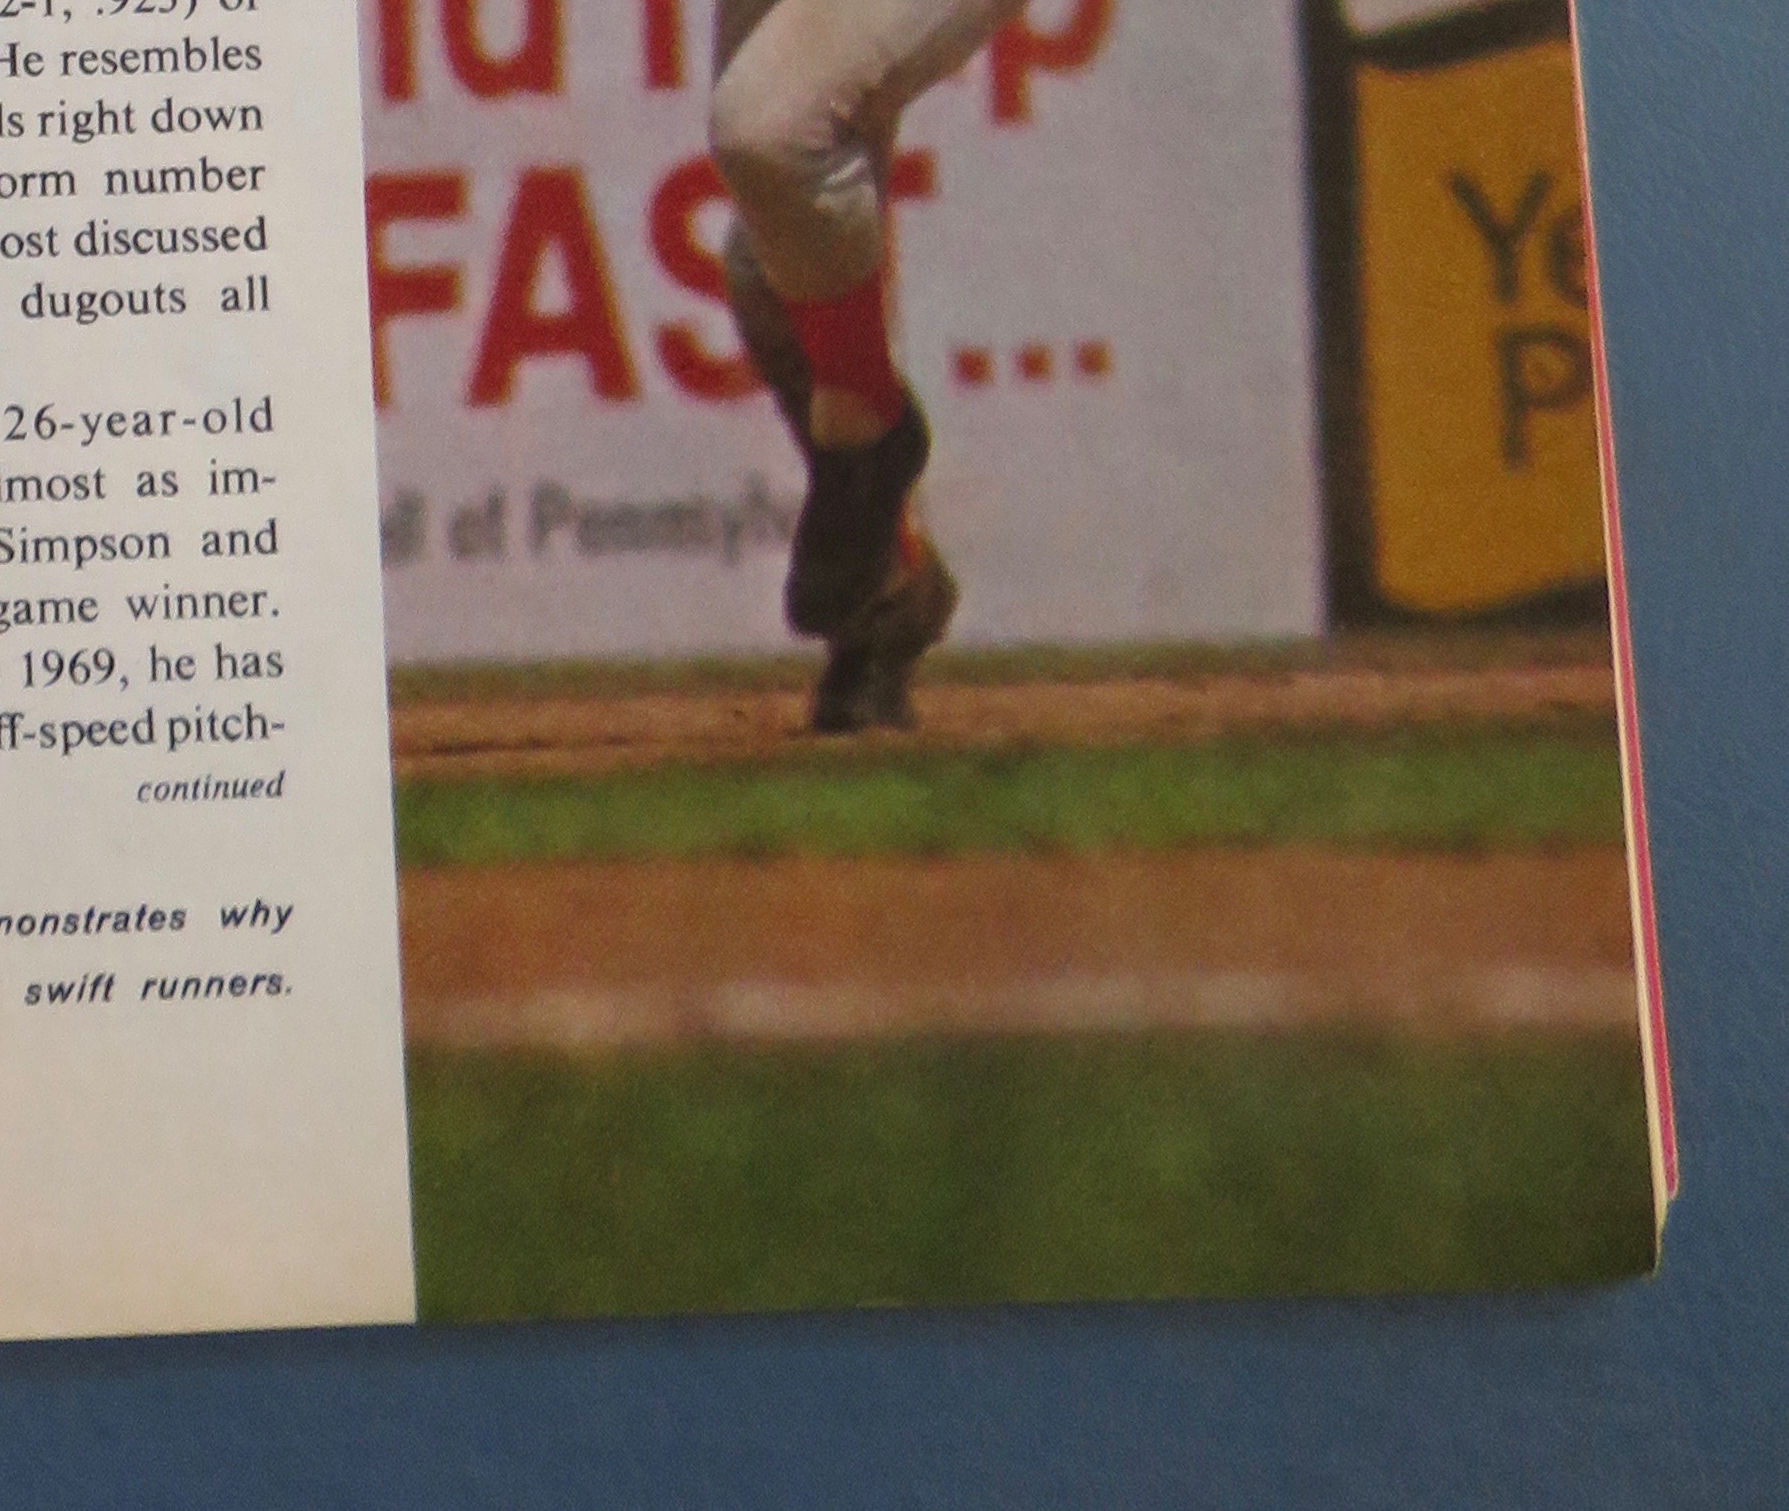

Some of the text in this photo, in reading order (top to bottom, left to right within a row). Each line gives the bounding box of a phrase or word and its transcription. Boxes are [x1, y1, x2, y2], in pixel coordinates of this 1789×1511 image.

[4, 394, 274, 448] 26-year-old
[125, 583, 280, 621] winner.
[167, 702, 285, 753] pitch-
[137, 769, 286, 803] continued
[220, 897, 294, 935] why
[24, 972, 115, 1006] swift
[140, 972, 292, 1001] runners.
